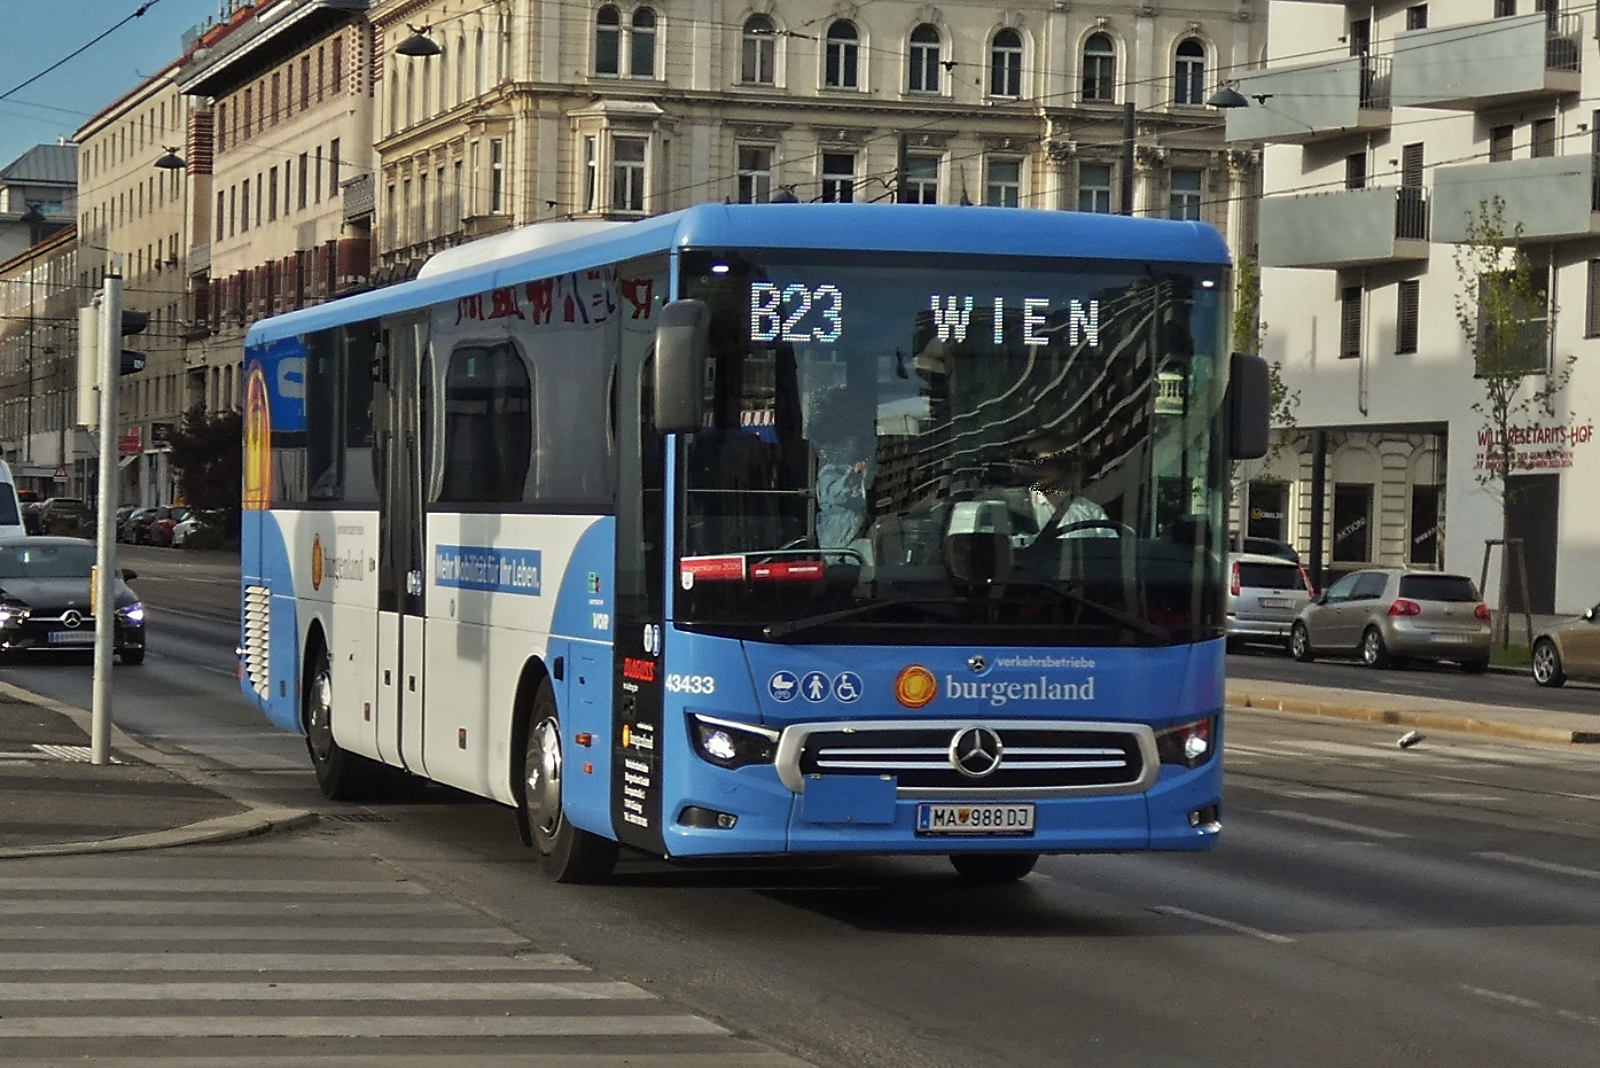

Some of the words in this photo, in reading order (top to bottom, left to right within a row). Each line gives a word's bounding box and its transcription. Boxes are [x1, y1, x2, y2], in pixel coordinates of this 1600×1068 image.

[750, 281, 843, 342] B23
[930, 294, 1100, 347] WIEN
[1477, 427, 1507, 446] WILL
[996, 655, 1096, 668] verkehrsbetriebe
[665, 674, 715, 694] 43433
[946, 674, 1095, 706] burgenland
[934, 808, 957, 826] MA
[971, 808, 1003, 827] 988
[1007, 808, 1029, 826] DJ
